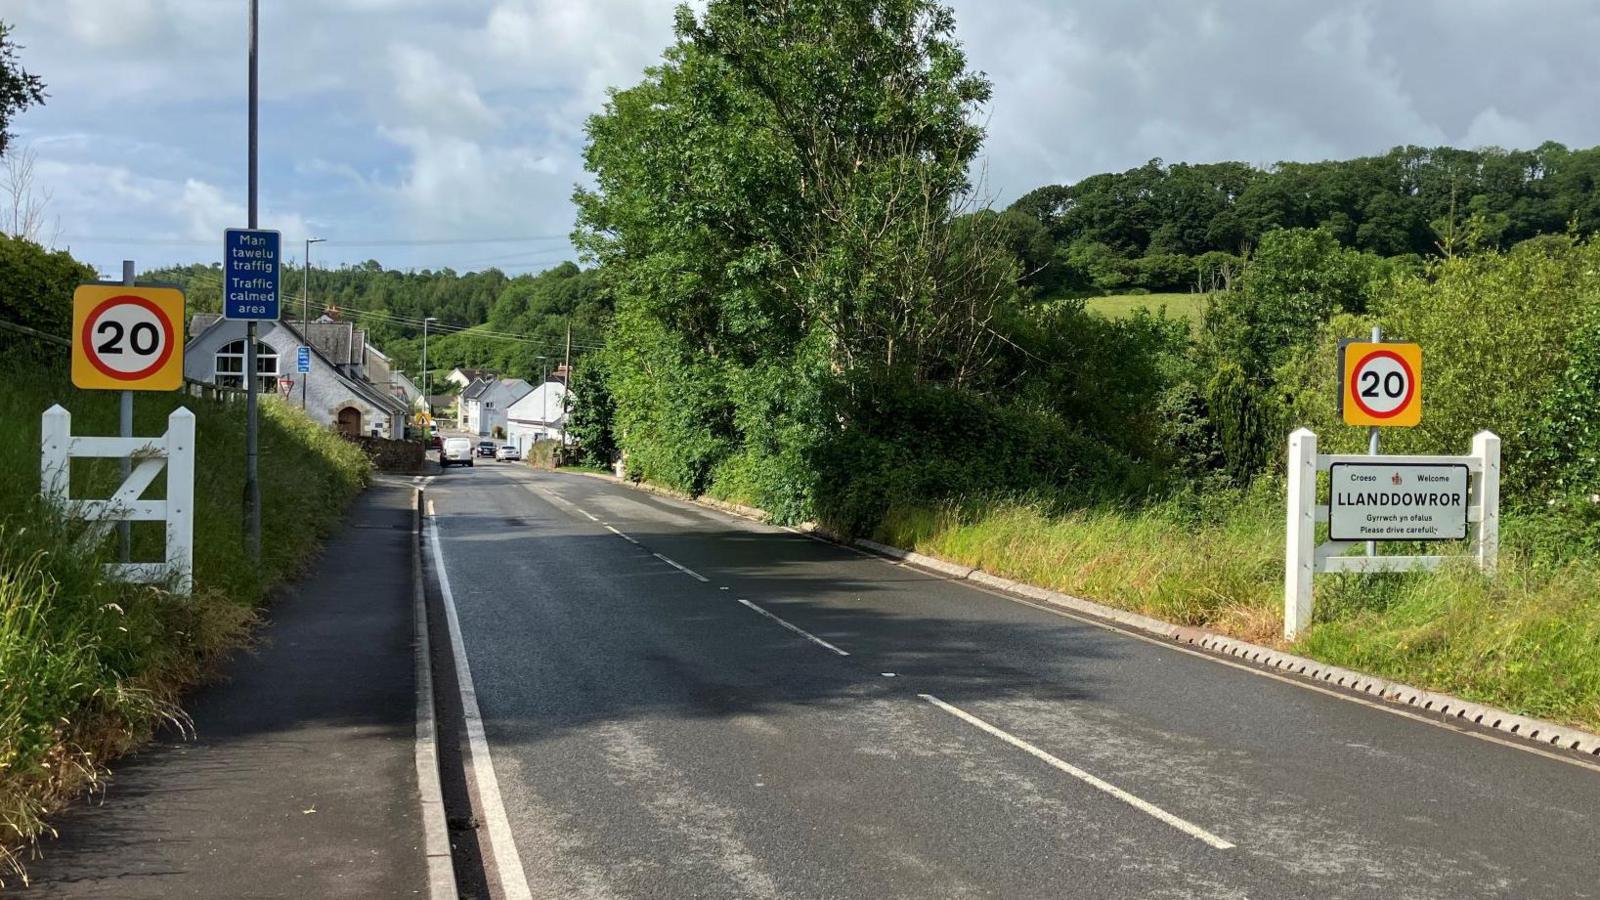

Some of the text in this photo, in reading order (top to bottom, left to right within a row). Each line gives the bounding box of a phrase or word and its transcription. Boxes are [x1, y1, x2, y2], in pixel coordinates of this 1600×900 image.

[239, 235, 266, 246] Man
[232, 247, 274, 258] tawelu
[233, 260, 273, 273] traffig
[232, 277, 273, 289] Traffic
[230, 291, 275, 302] calmed
[238, 304, 266, 314] area
[97, 320, 160, 356] 20
[1361, 370, 1405, 399] 20
[1350, 473, 1450, 482] Croeso Welcome
[1338, 492, 1461, 507] LLANDDOWROR
[1366, 514, 1433, 523] Gyrrwch yn ofalus
[1360, 526, 1385, 534] Please
[1386, 526, 1404, 534] drive
